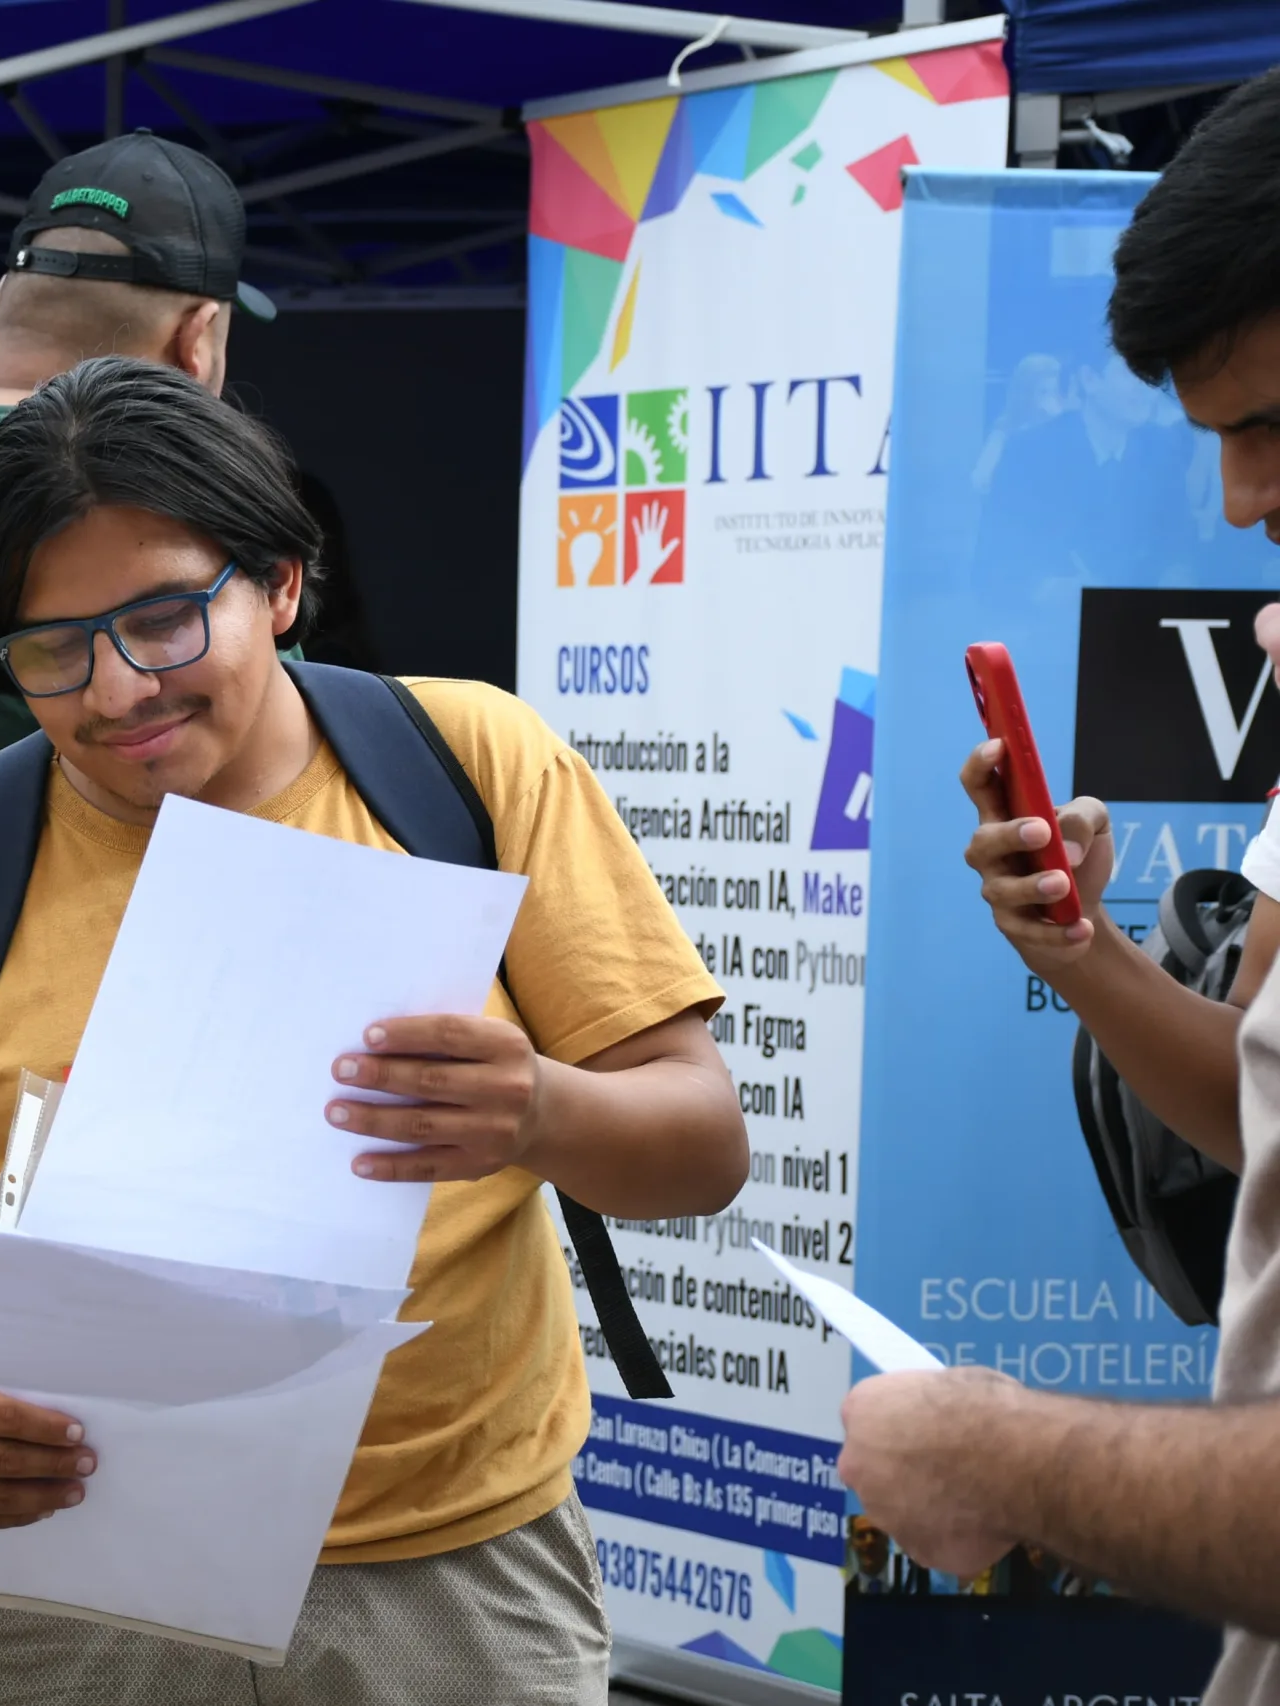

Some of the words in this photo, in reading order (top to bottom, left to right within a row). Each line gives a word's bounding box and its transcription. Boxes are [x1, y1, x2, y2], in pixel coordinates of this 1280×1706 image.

[714, 511, 797, 531] INSTITUTO
[799, 510, 818, 528] DE
[556, 644, 651, 696] CURSOS
[695, 741, 706, 773] a
[713, 731, 730, 773] la
[699, 798, 791, 844] Artificial
[723, 875, 760, 911] con
[768, 868, 796, 918] IA,
[802, 870, 863, 918] Make
[723, 934, 744, 977] IA
[752, 946, 789, 981] con
[743, 1003, 807, 1059] Figma
[739, 1080, 776, 1118] con
[783, 1075, 805, 1121] IA
[782, 1145, 830, 1193] nivel
[838, 1152, 848, 1195] 1
[781, 1214, 830, 1262] nivel
[838, 1221, 854, 1266] 2
[672, 1264, 697, 1308] de
[702, 1276, 816, 1330] contenidos
[921, 1277, 1119, 1321] ESCUELA
[649, 1329, 717, 1380] ciales
[723, 1350, 760, 1388] con
[768, 1346, 790, 1394] IA
[995, 1331, 1218, 1386] HOTELERÍ
[615, 1413, 669, 1454] Lorenzo
[670, 1424, 711, 1463] Chico
[722, 1436, 742, 1469] La
[744, 1440, 810, 1484] Comarca
[586, 1452, 633, 1490] Centro
[644, 1465, 681, 1502] Calle
[682, 1472, 703, 1507] Bs
[703, 1478, 724, 1512] As
[726, 1483, 754, 1518] 135
[755, 1491, 805, 1530] primer
[806, 1501, 839, 1539] piso
[596, 1538, 753, 1621] 93875442676
